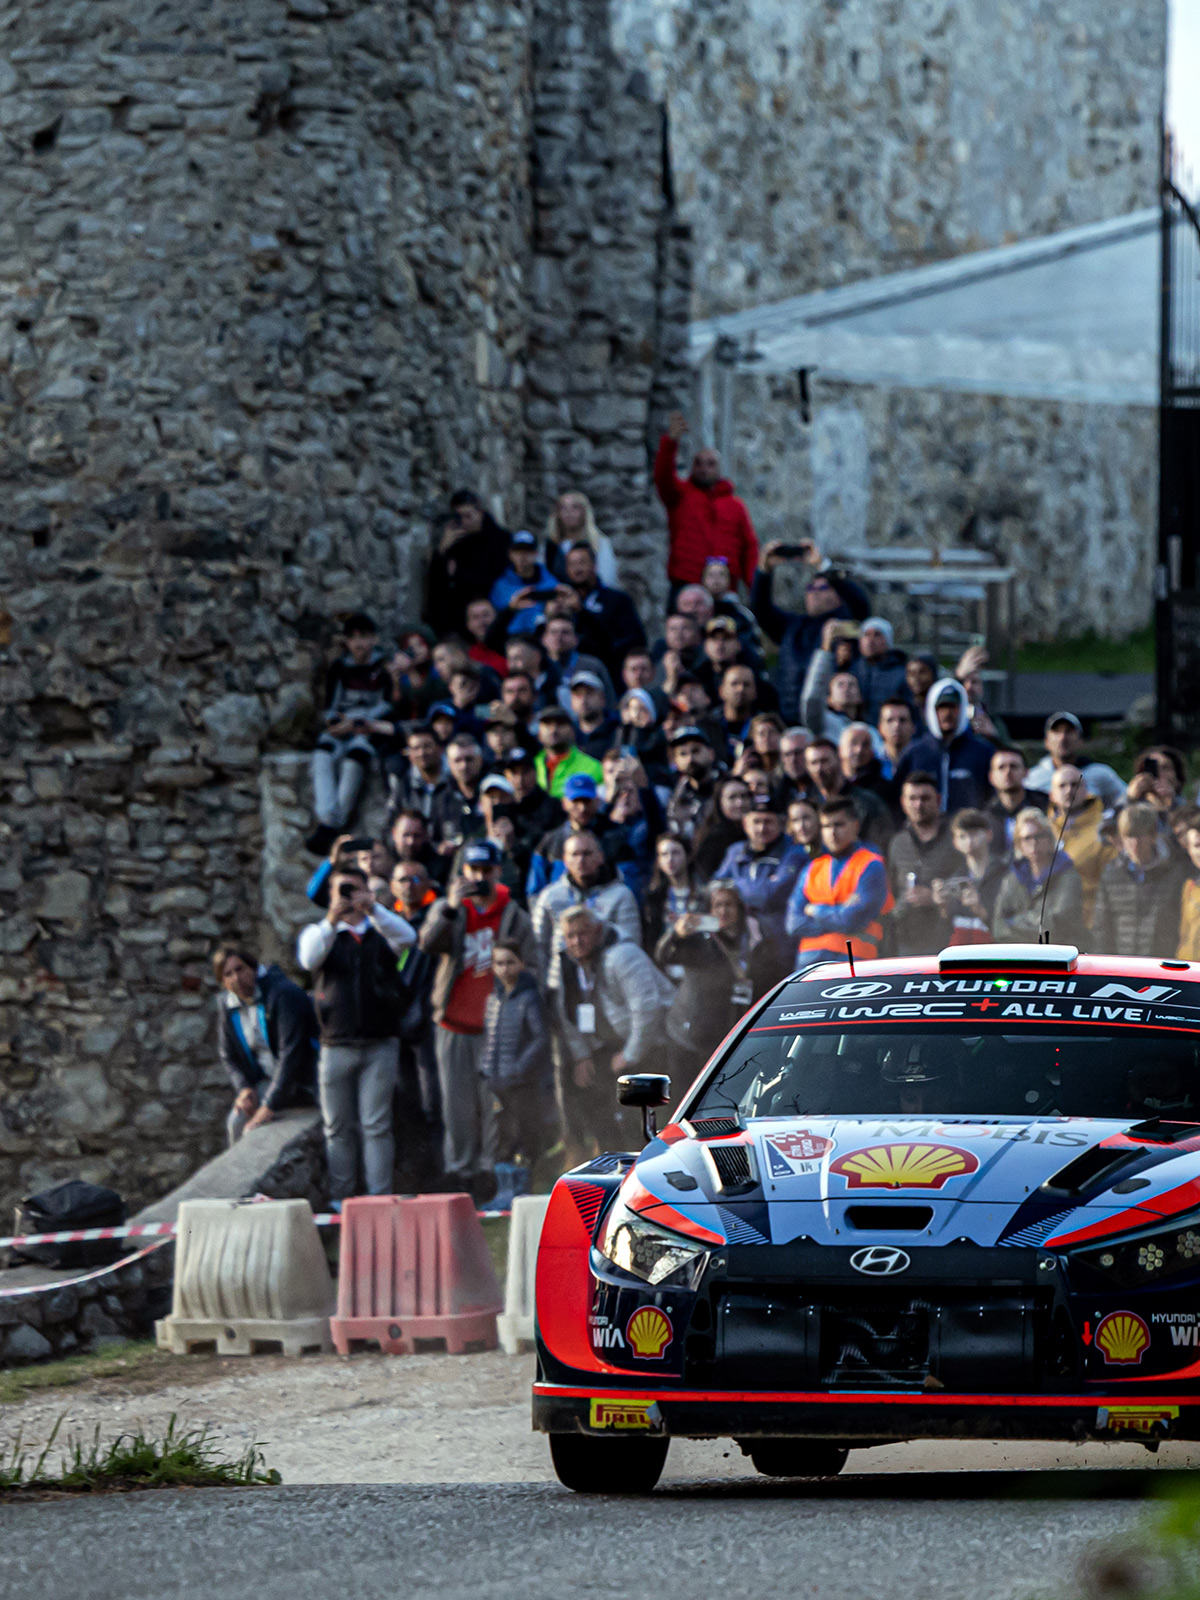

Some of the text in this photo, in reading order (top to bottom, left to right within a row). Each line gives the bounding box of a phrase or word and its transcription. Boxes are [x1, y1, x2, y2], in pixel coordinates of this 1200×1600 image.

[903, 980, 1077, 994] HYUNDAI
[1001, 1003, 1062, 1017] ALL
[1072, 1005, 1144, 1022] LIVE
[870, 1124, 1089, 1148] MOBIS
[1151, 1313, 1196, 1324] HYUNDAI
[592, 1323, 625, 1348] WIA
